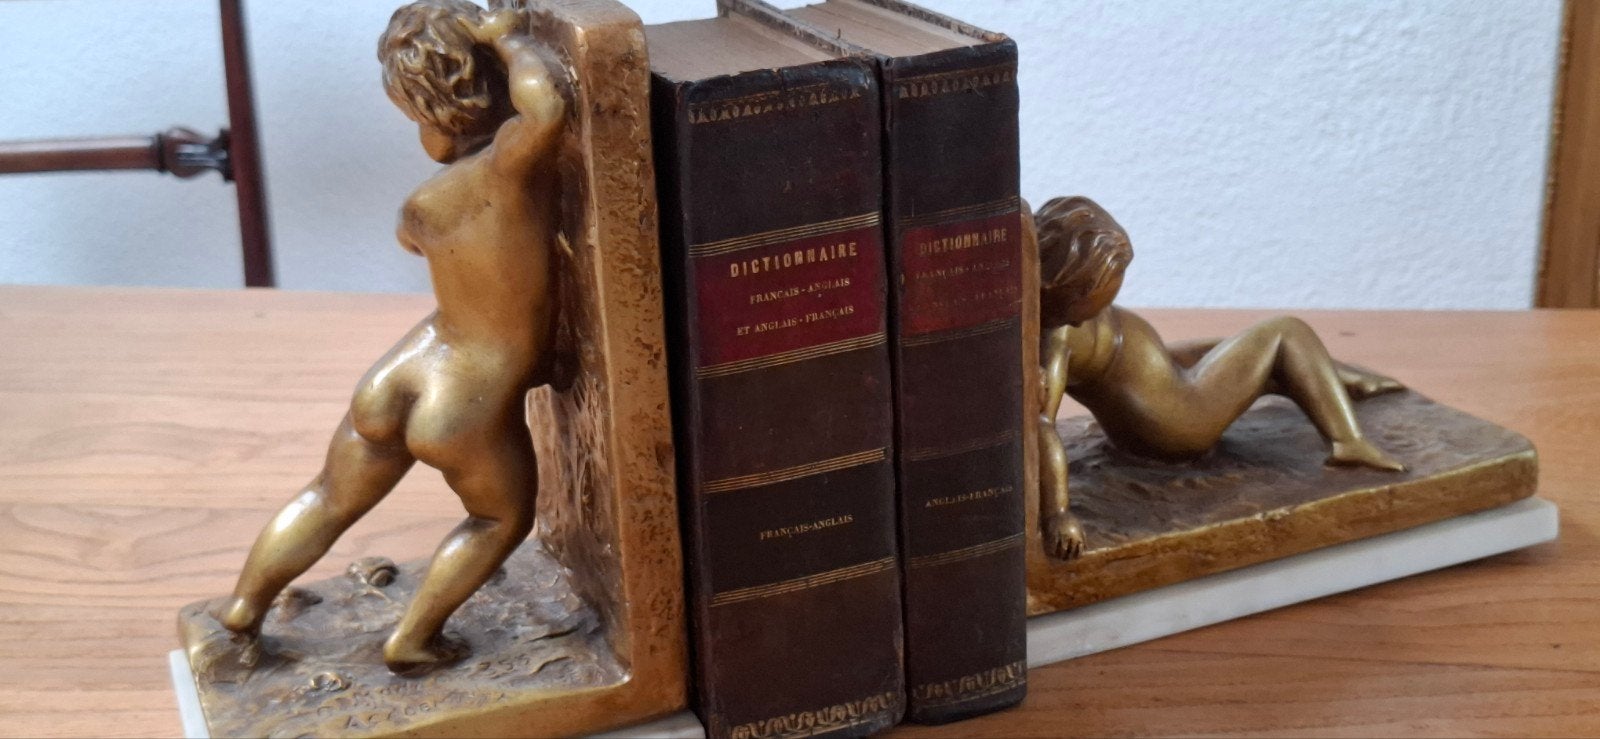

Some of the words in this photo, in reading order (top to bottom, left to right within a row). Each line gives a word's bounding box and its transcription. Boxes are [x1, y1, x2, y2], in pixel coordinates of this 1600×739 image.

[919, 228, 1007, 257] DICTIONNAIRE
[730, 242, 858, 278] DICTIONNAIRE
[736, 326, 751, 336] ET
[760, 514, 854, 540] FRANÇAIS-ANGLAIS
